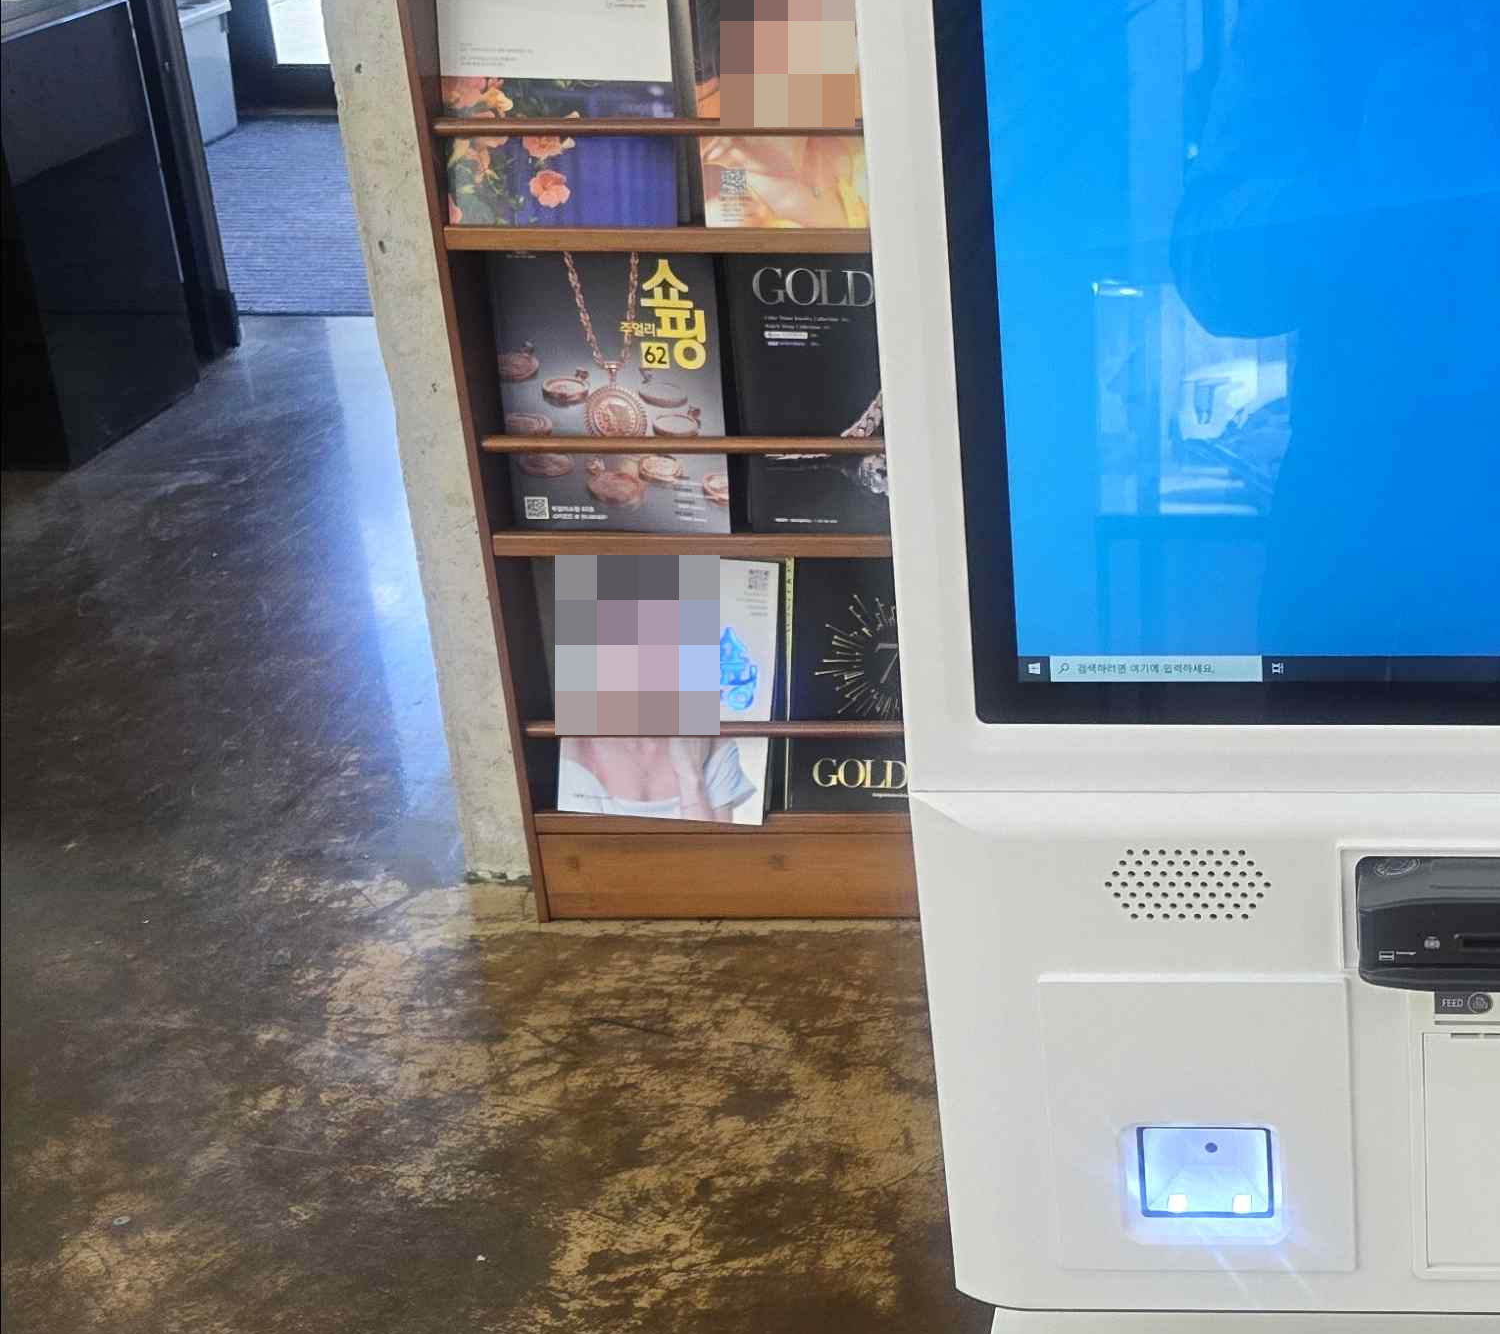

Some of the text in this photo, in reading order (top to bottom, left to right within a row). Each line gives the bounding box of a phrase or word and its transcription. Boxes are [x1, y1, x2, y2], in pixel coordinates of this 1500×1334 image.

[752, 267, 875, 307] GOLD
[640, 258, 707, 370] 쇼핑
[620, 320, 656, 337] 주얼리
[643, 346, 668, 365] 62
[812, 758, 908, 789] GOLD
[1441, 998, 1464, 1008] FEED
